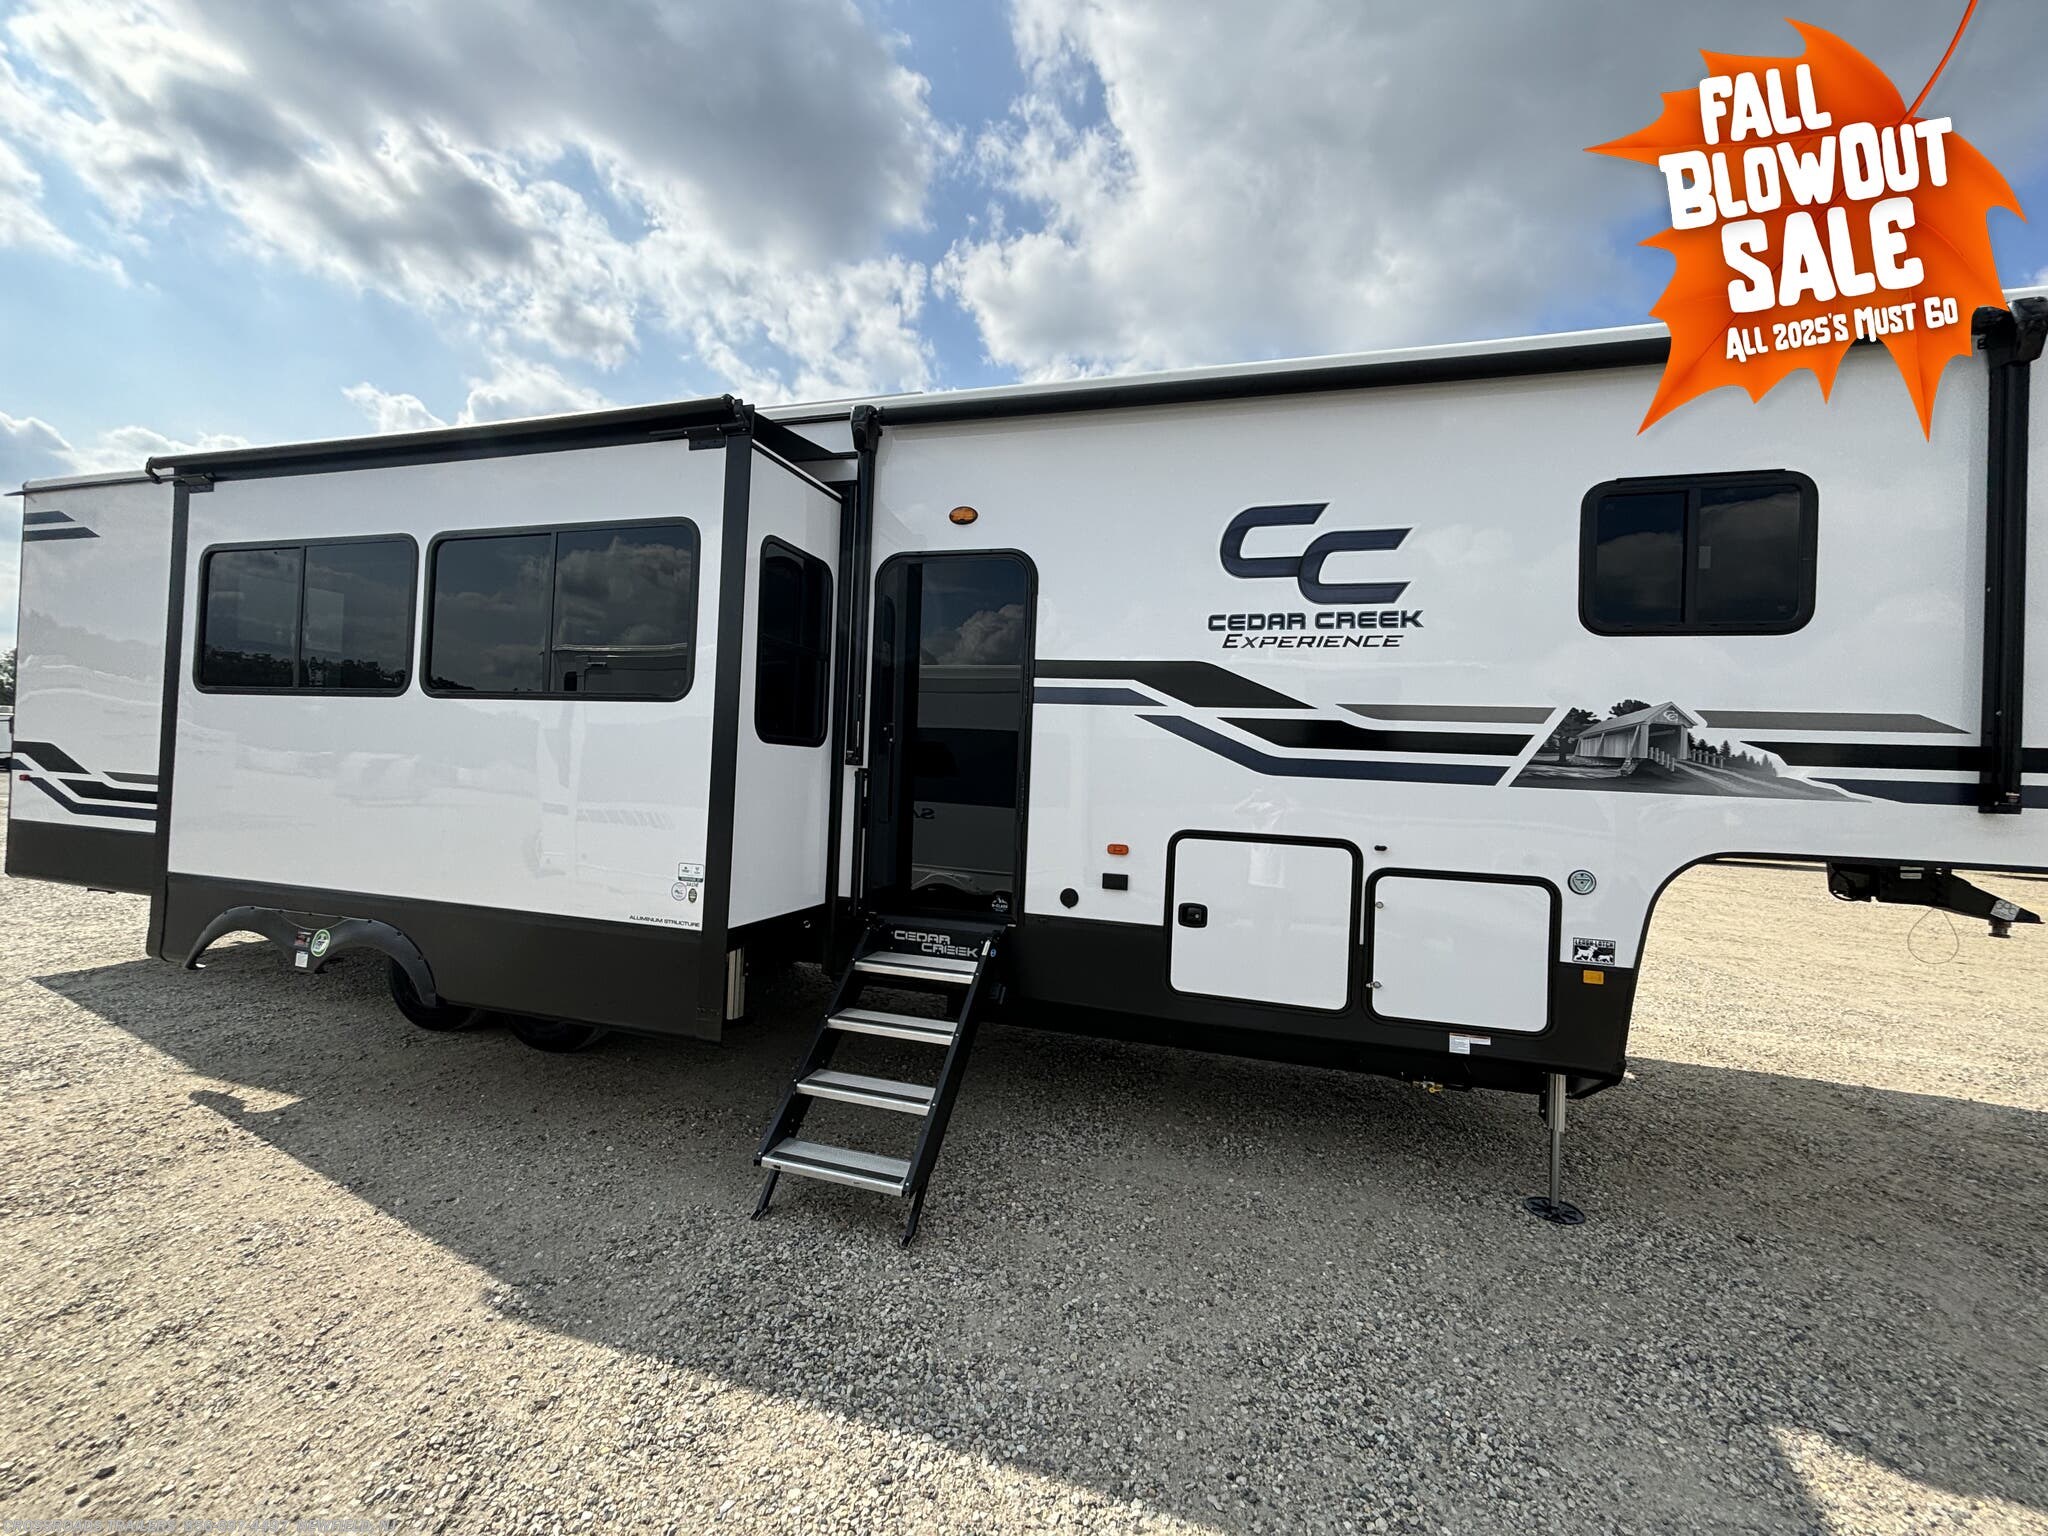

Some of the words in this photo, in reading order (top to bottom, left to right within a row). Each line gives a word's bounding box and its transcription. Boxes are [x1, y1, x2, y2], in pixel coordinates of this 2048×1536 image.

[1208, 612, 1306, 631] CEDAR
[1314, 610, 1424, 629] CREEK
[894, 929, 951, 945] CEDAR
[921, 942, 979, 958] CREEK
